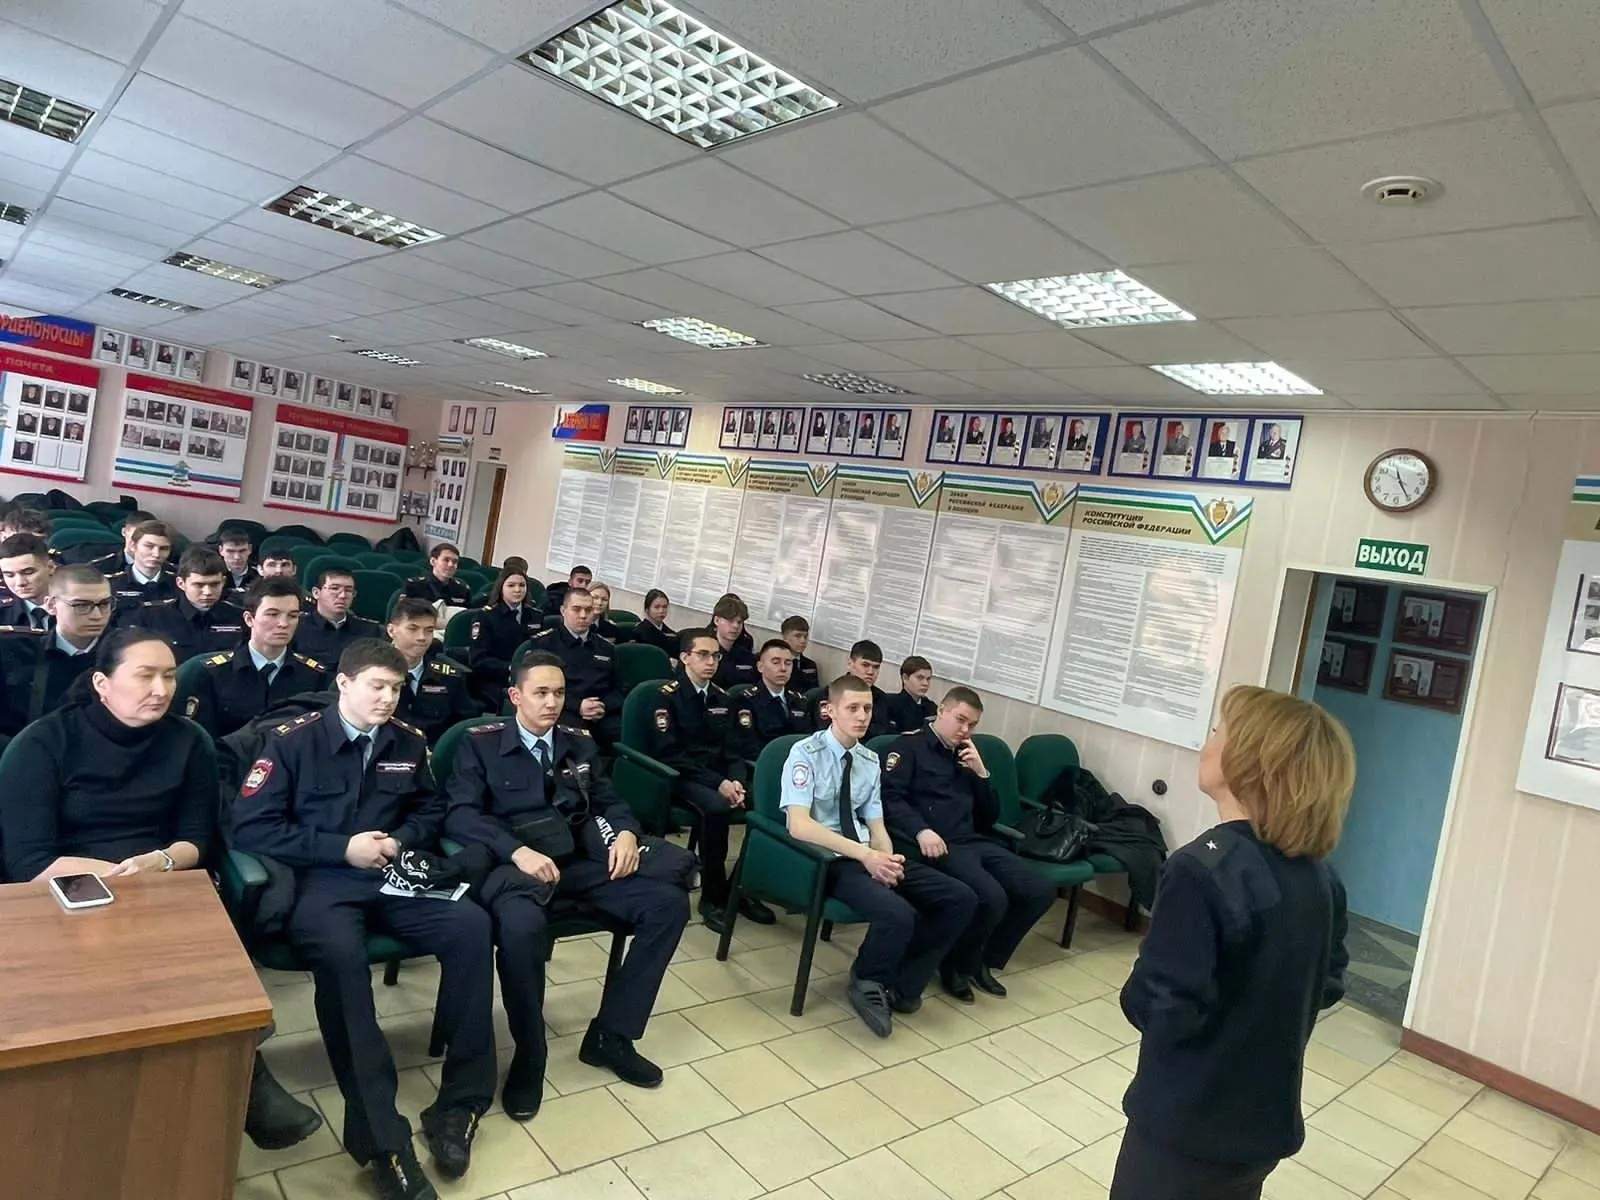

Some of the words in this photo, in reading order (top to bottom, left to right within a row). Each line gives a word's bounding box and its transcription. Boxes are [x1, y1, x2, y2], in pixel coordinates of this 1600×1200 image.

[0, 314, 85, 347] РДЕНОНОСЦЫ
[1082, 517, 1135, 529] РОССИЙСКОЙ
[1136, 523, 1192, 535] ФЕДЕРАЦИИ
[1084, 510, 1144, 522] КОНСТИТУЦИЯ
[1358, 544, 1425, 572] ВЫХОД
